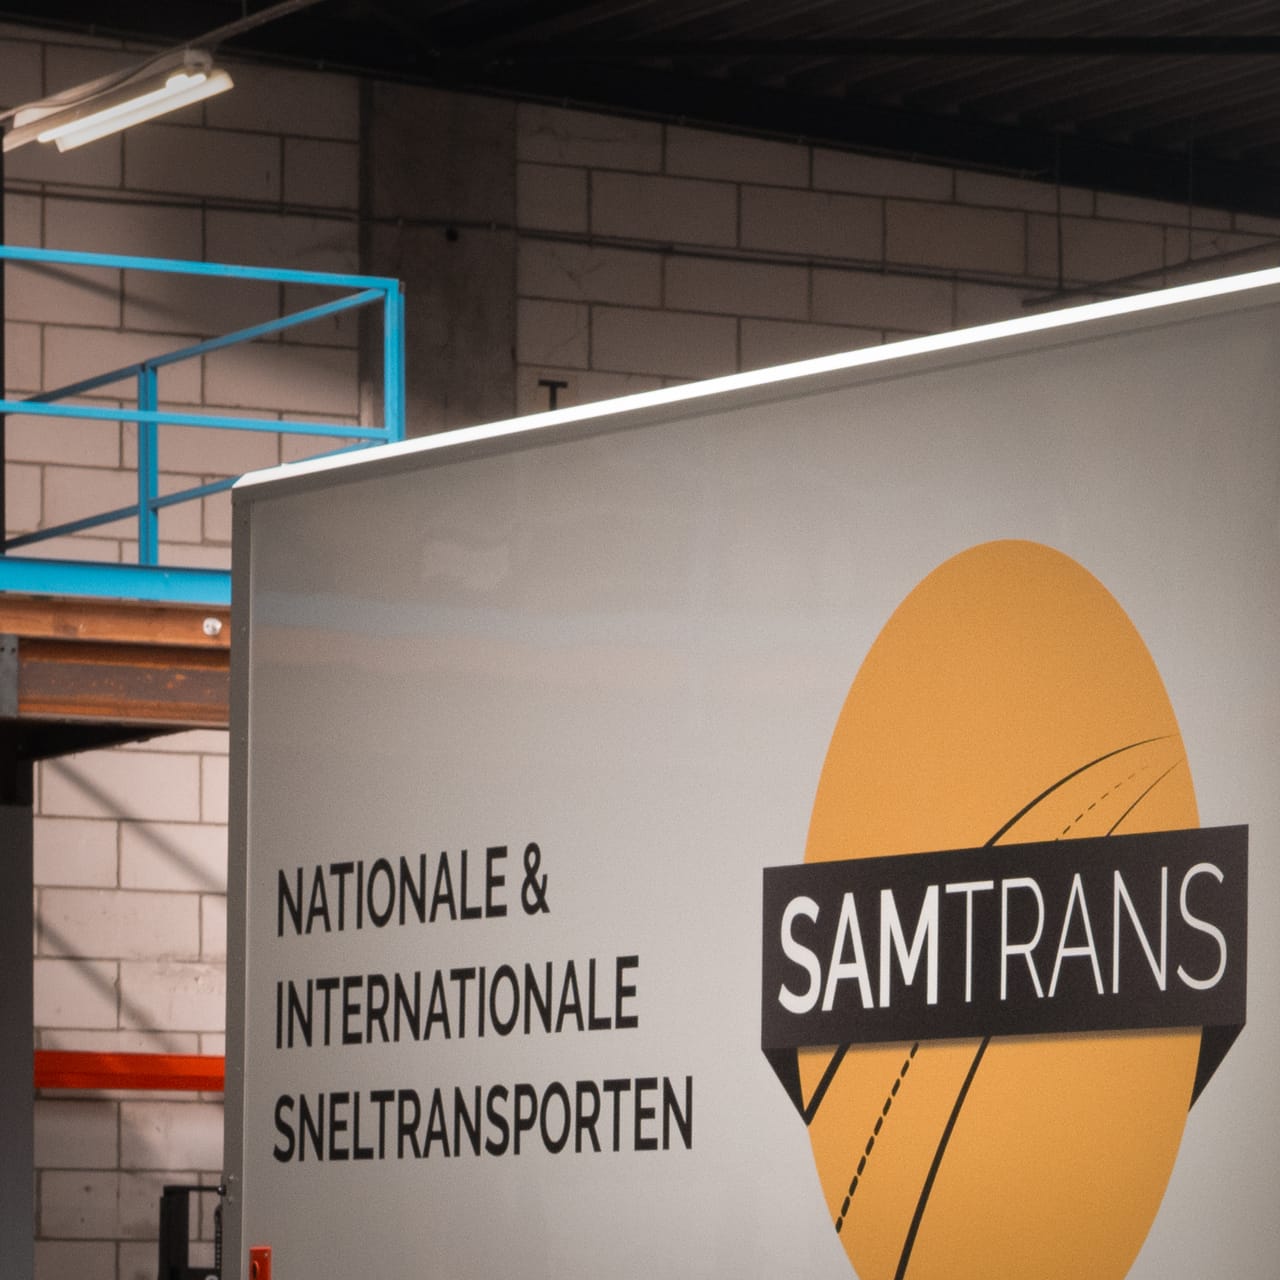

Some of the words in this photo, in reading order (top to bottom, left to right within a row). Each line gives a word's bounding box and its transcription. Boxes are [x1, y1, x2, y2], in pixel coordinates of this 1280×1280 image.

[277, 845, 508, 937] NATIONALE
[520, 841, 551, 916] &
[778, 862, 1228, 1014] SAMTRANS
[275, 955, 640, 1049] INTERNATIONALE
[273, 1075, 694, 1163] SNELTRANSPORTEN
